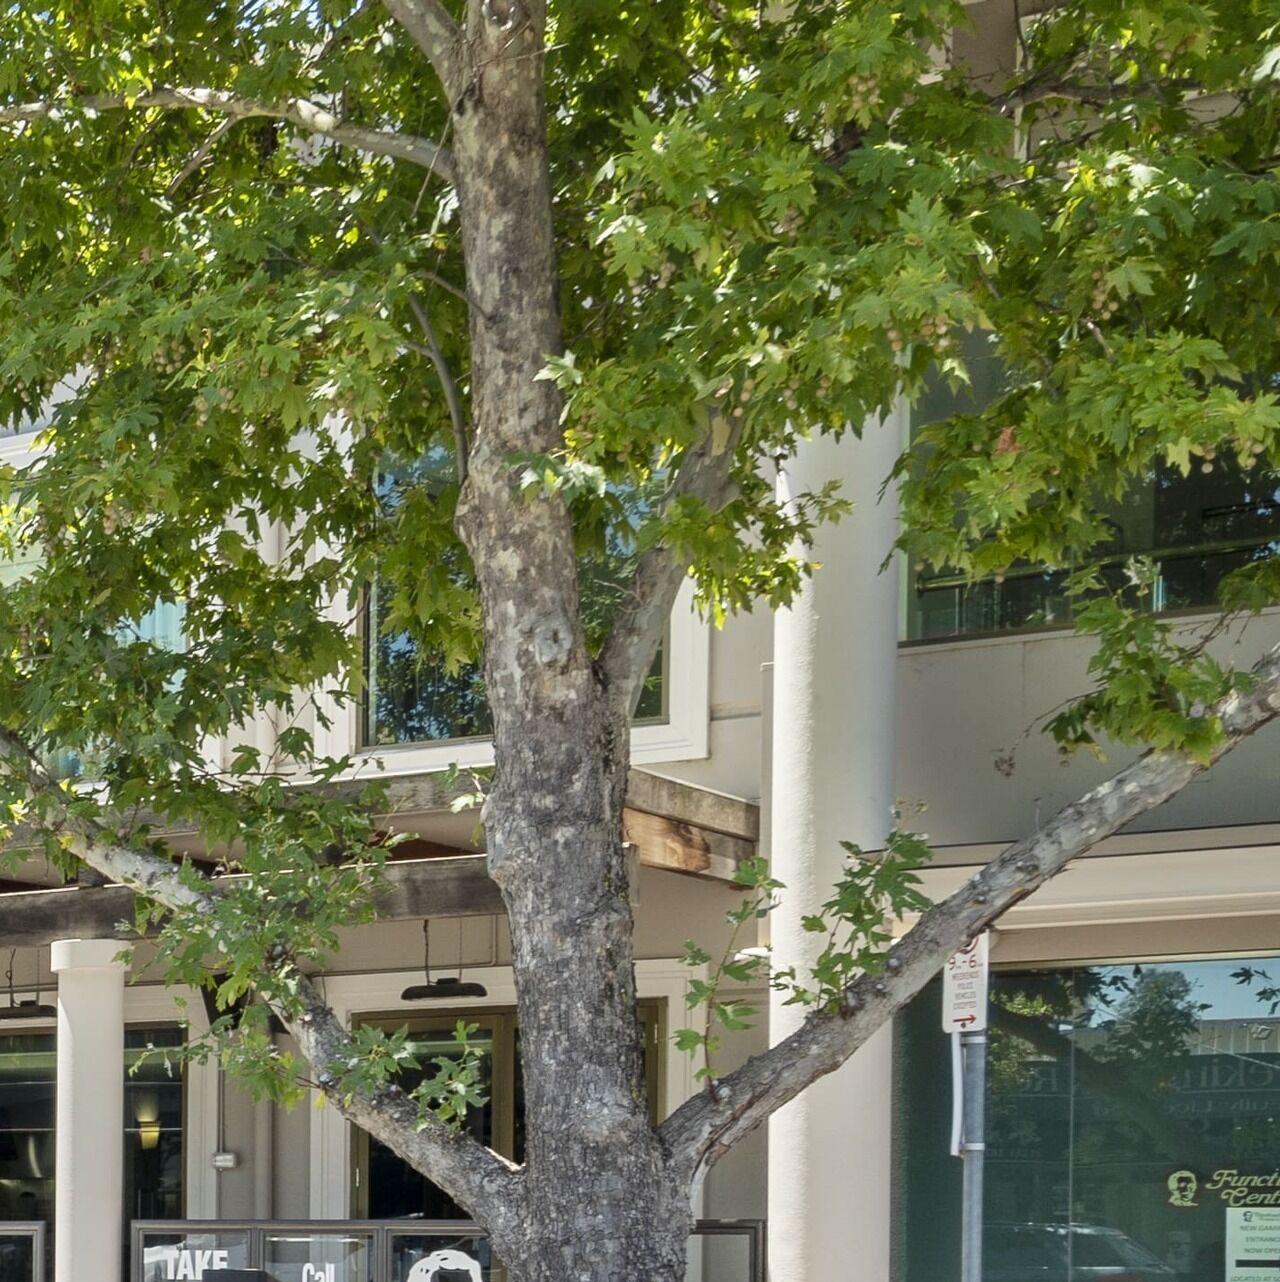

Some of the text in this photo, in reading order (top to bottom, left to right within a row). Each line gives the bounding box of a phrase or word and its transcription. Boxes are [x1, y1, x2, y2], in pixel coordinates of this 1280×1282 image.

[1205, 1168, 1280, 1189] Functi
[1220, 1187, 1280, 1206] Cent
[165, 1249, 229, 1280] TAKE
